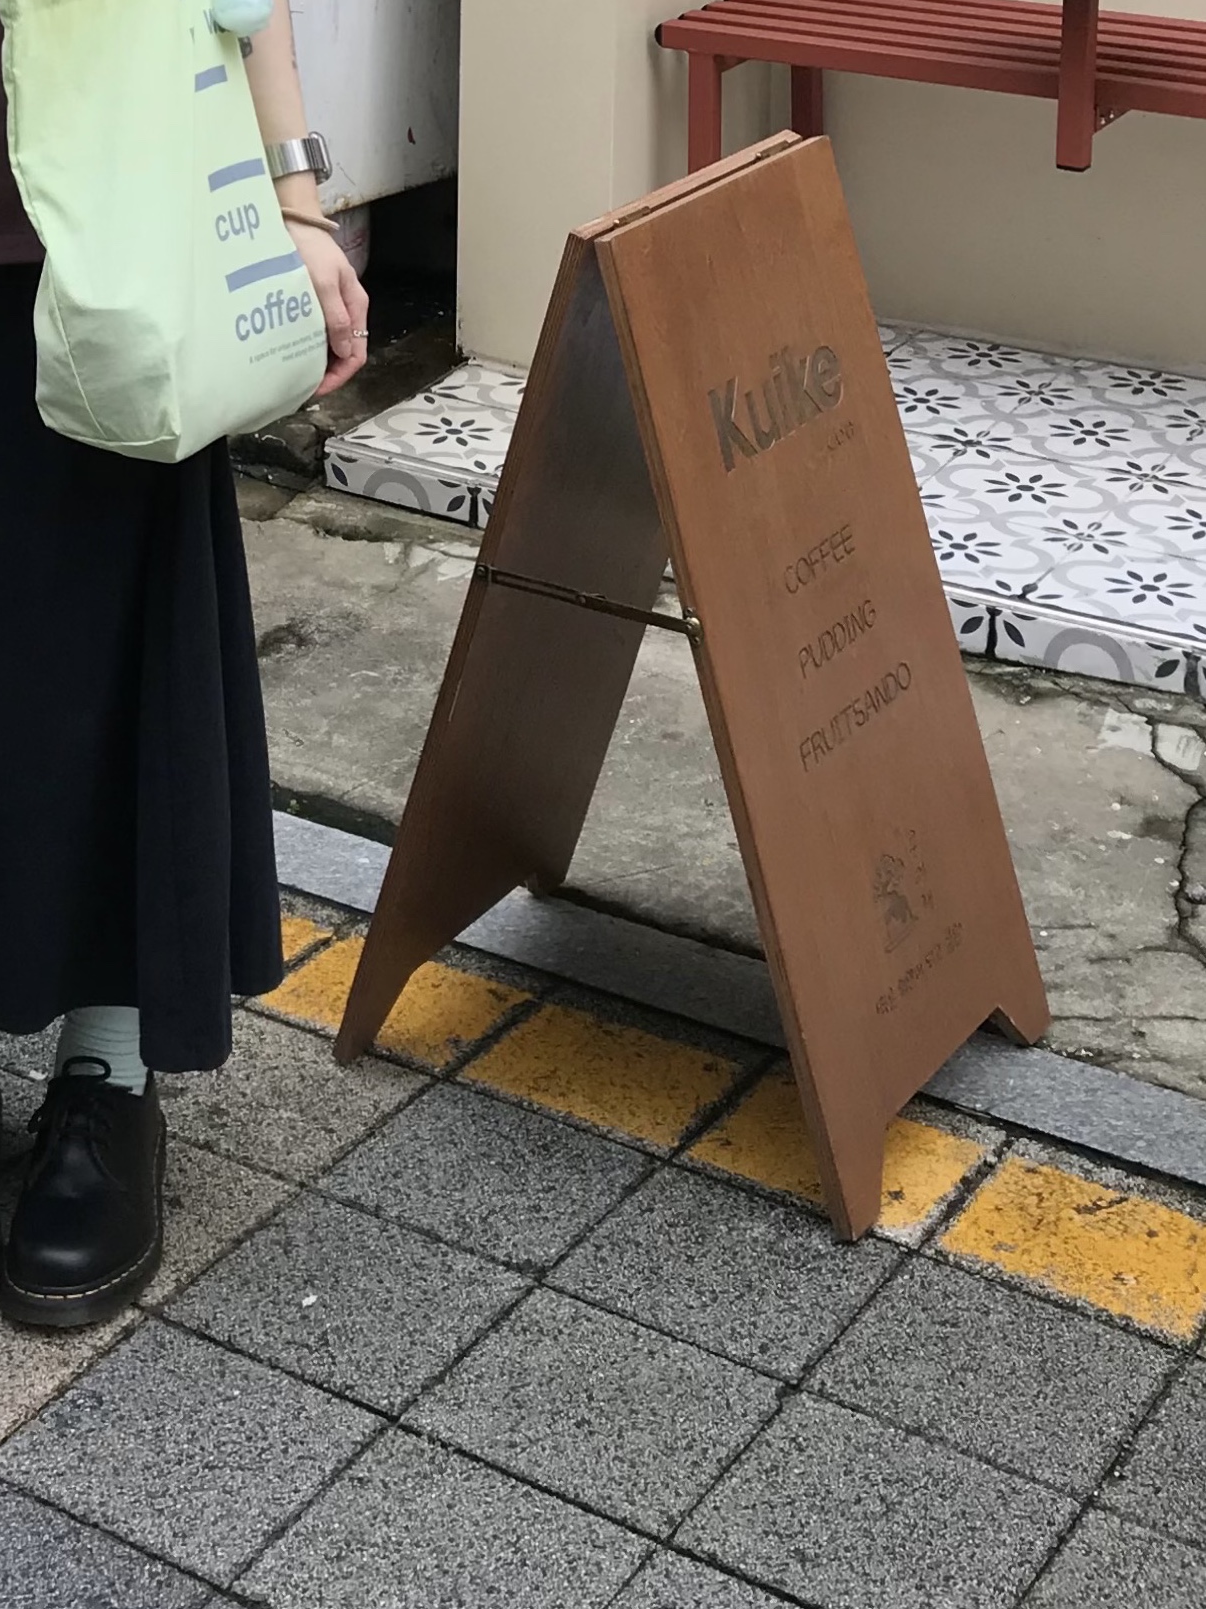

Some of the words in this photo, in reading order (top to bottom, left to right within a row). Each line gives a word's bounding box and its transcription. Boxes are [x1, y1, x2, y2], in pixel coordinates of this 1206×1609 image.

[214, 202, 260, 242] cup
[235, 289, 313, 341] coffee
[784, 523, 856, 595] COFFEE
[798, 599, 877, 680] PUDDING
[798, 661, 912, 773] FRUITSANDO
